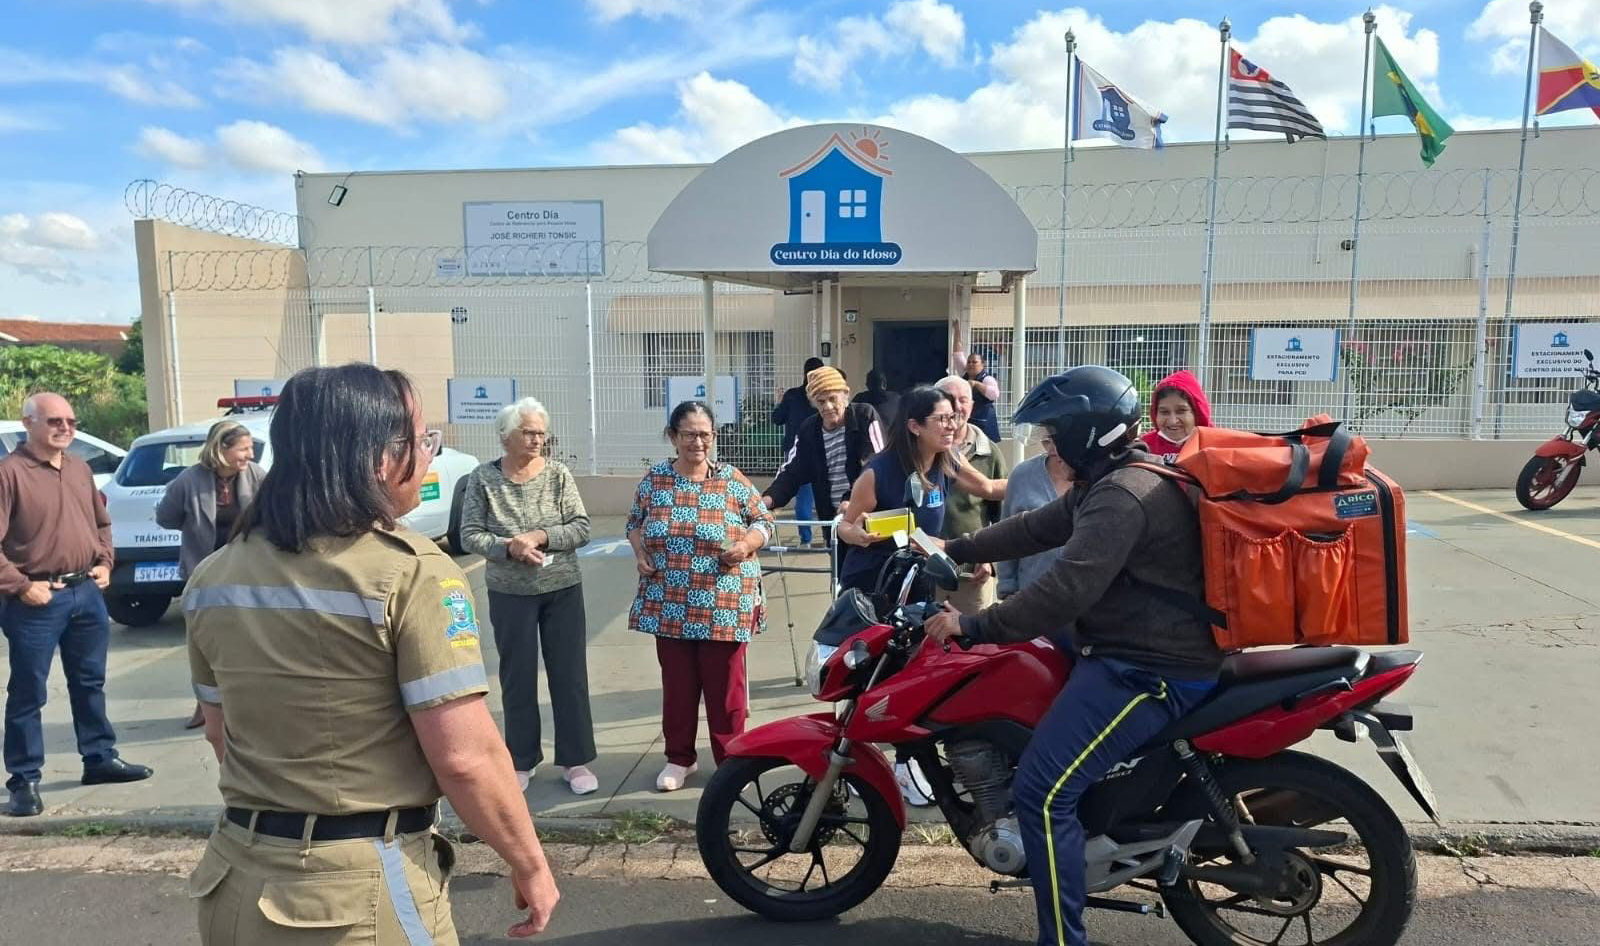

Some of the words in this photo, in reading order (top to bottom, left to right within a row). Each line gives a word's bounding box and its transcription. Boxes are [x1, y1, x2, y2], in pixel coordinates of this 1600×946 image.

[507, 210, 540, 220] Centro
[774, 249, 817, 260] Centro
[820, 248, 840, 260] Dia
[843, 248, 860, 260] do
[863, 248, 897, 260] Idoso
